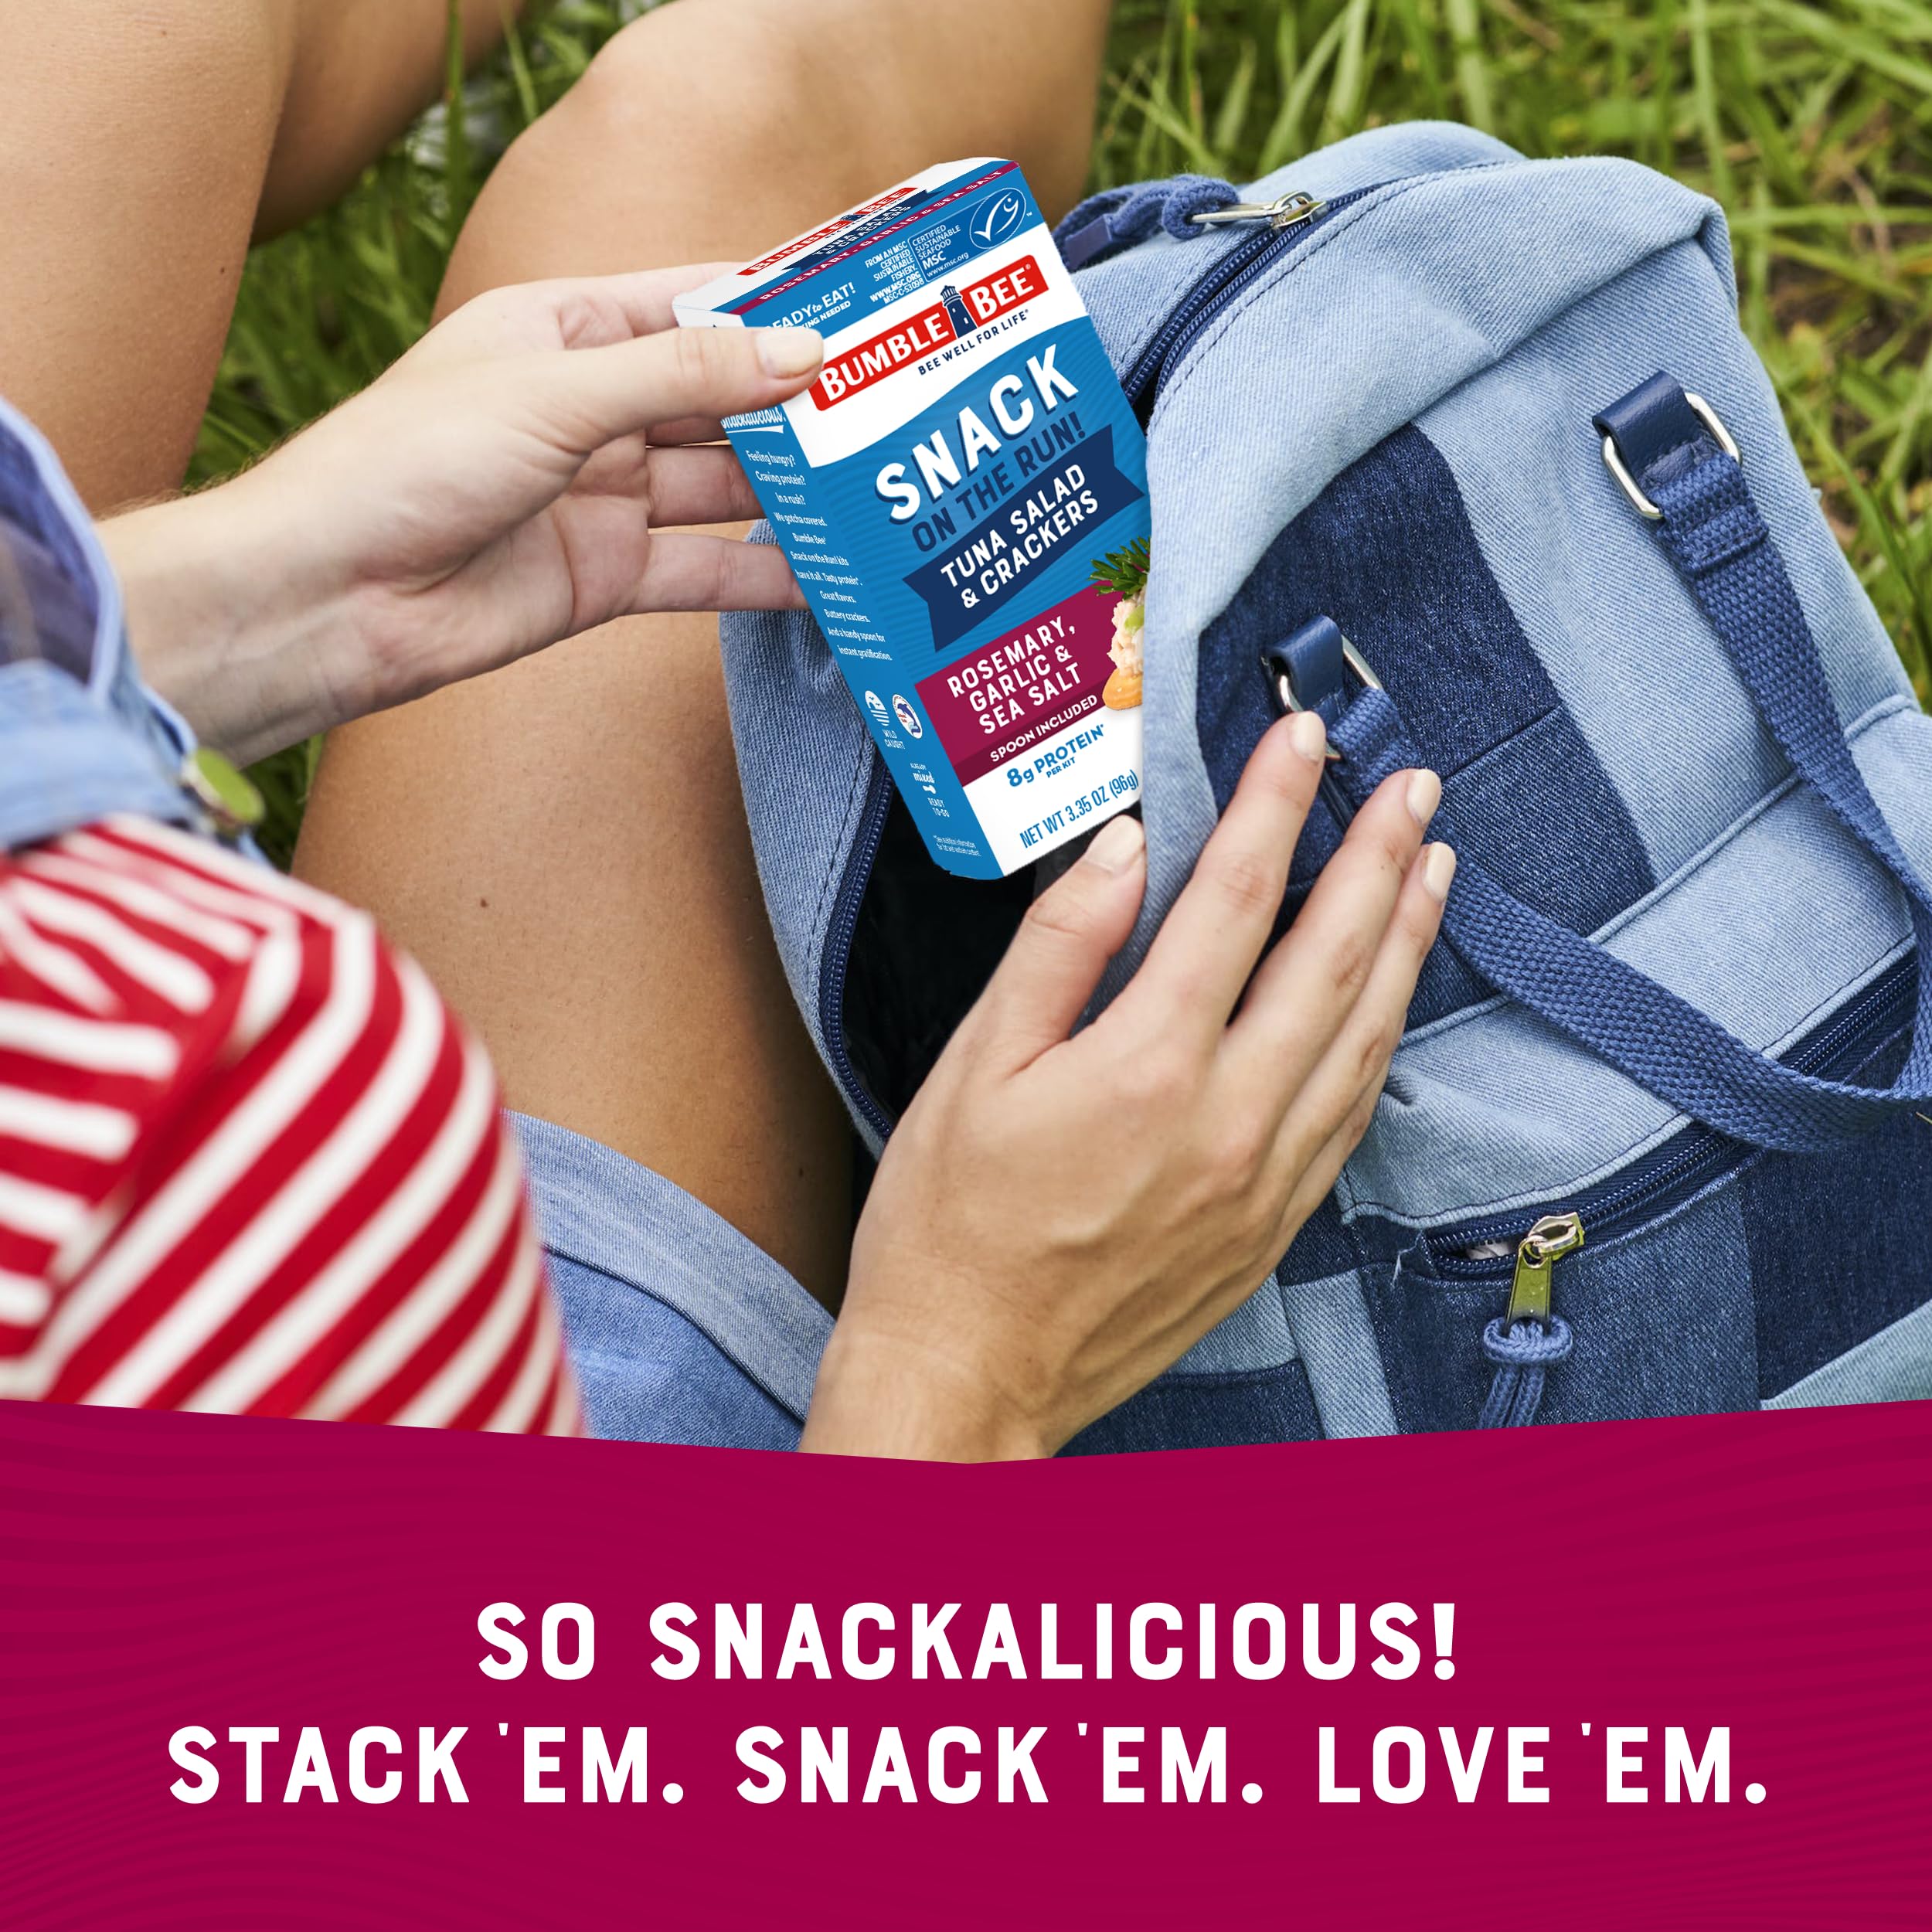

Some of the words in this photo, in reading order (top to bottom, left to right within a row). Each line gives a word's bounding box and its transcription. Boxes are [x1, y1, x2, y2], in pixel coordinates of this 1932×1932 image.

[859, 216, 919, 247] GARLIC
[933, 190, 966, 208] SEA
[965, 171, 1002, 191] SALT
[750, 221, 846, 271] BUMBLE
[859, 190, 908, 213] BEE
[912, 224, 947, 247] CERTIFIED
[915, 225, 961, 253] SUSTAINABLE
[812, 234, 854, 256] TUNA
[865, 250, 883, 268] FROM
[893, 240, 908, 255] MSC
[919, 239, 951, 260] SEAFOOD
[873, 256, 915, 282] SUSTAINABLE
[880, 249, 910, 270] CERTIFIED
[922, 250, 947, 270] MSC
[927, 252, 969, 277] www.msc.org
[870, 271, 921, 302] WWW.MSC.ORG
[891, 265, 917, 282] FISHERY.
[811, 302, 823, 313] to
[821, 281, 856, 308] EAT!
[883, 278, 924, 304] MSC-C-53098
[819, 301, 852, 321] NEEDED
[818, 312, 949, 401] BUMBLE
[918, 359, 941, 376] BEE
[942, 340, 975, 362] WELL
[976, 325, 999, 344] FOR
[875, 344, 1079, 523] SNACK
[746, 450, 772, 465] Feeling
[767, 451, 796, 468] hungry?
[755, 471, 782, 485] Craving
[780, 474, 806, 486] protein?
[912, 507, 957, 552] ON
[956, 461, 1015, 521] THE
[1014, 411, 1086, 478] RUN!
[775, 492, 784, 502] In
[788, 494, 806, 505] rush?
[773, 512, 785, 522] We
[784, 514, 804, 525] gotcha
[803, 516, 828, 526] covered.
[940, 529, 1008, 587] TUNA
[1010, 464, 1085, 534] SALAD
[792, 532, 815, 543] Bumble
[961, 588, 981, 608] &
[979, 490, 1098, 595] CRACKERS
[790, 551, 809, 562] Snack
[820, 590, 837, 600] Great
[835, 591, 856, 603] flavors.
[947, 616, 1075, 698] ROSEMARY,
[969, 655, 1051, 713] GARLIC
[1054, 645, 1073, 663] &
[979, 699, 1025, 734] SEA
[1028, 662, 1081, 706] SALT
[990, 730, 1035, 762] SPOON
[1035, 694, 1097, 736] INCLUDED
[1006, 767, 1035, 787] 8g
[1046, 765, 1061, 777] PER
[1062, 757, 1076, 771] KIT
[1019, 823, 1043, 849] NET
[1043, 811, 1065, 833] WT
[1065, 794, 1092, 821] 3.35
[1093, 786, 1110, 808] OZ
[1110, 770, 1139, 799] (96g)
